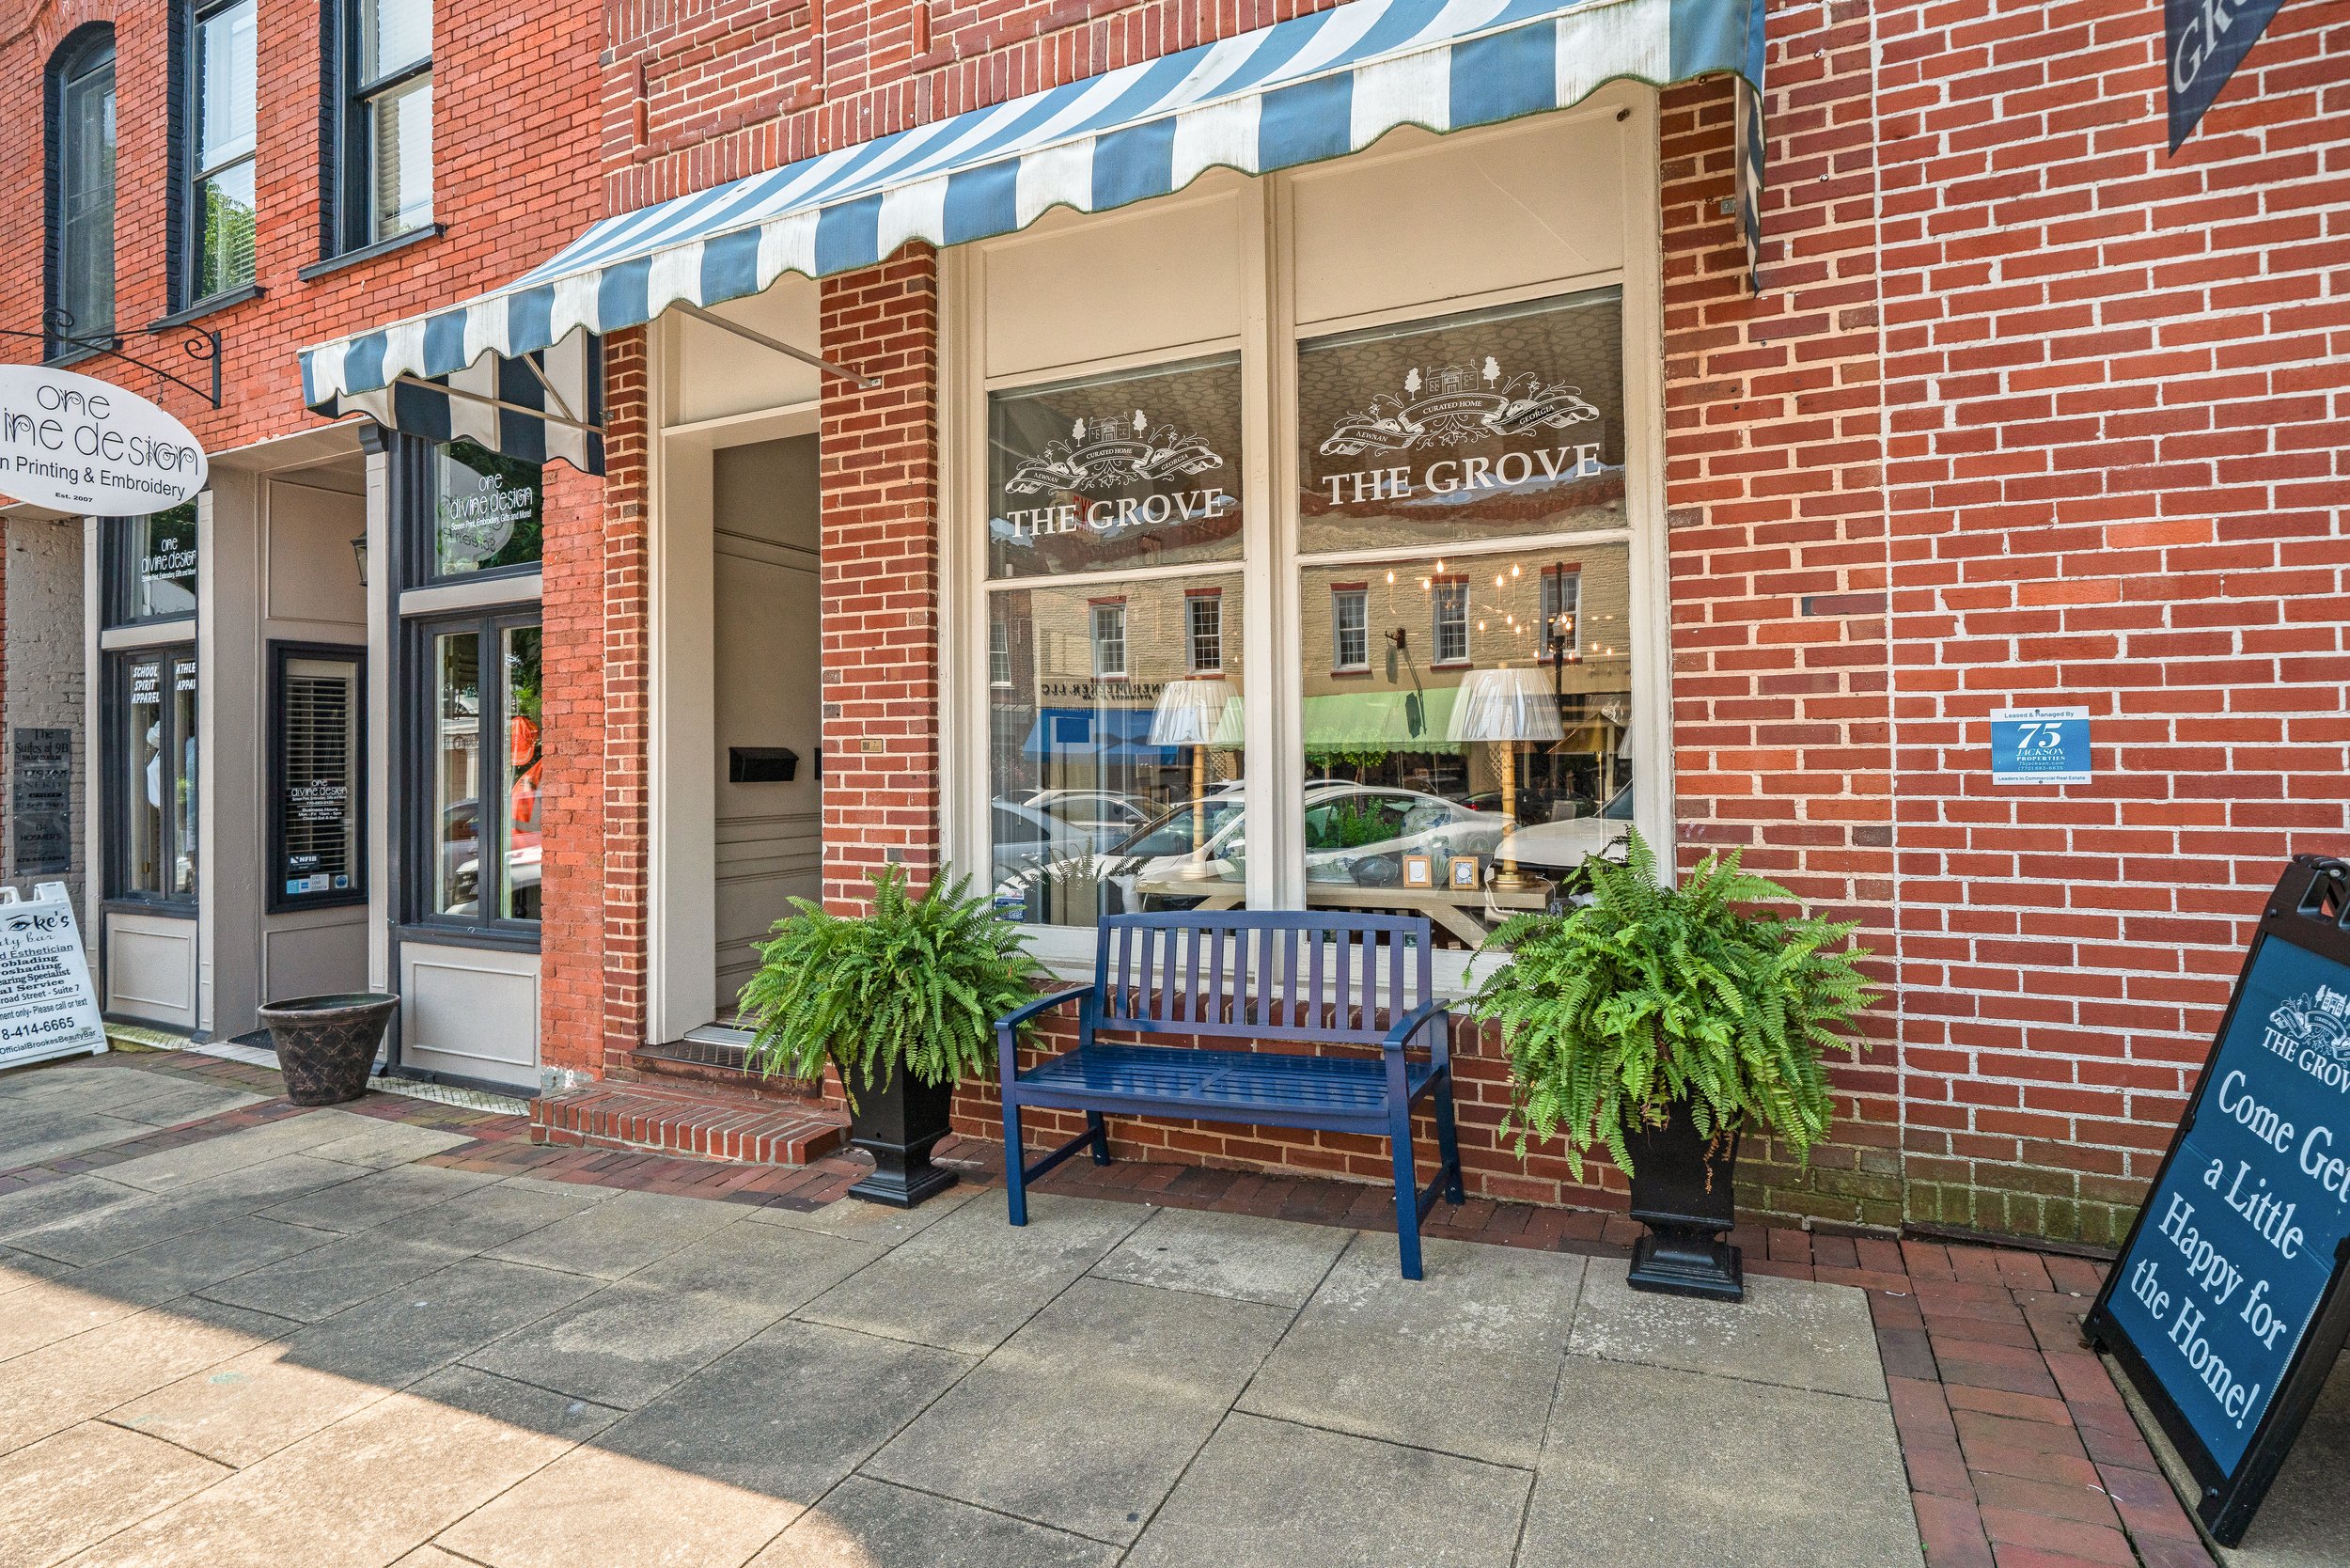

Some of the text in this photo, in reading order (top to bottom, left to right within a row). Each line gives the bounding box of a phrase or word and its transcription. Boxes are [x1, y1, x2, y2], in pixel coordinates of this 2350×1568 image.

[2173, 0, 2247, 94] GR
[37, 385, 110, 419] one
[1422, 402, 1458, 415] CURATED
[1519, 404, 1555, 425] GEORGIA
[1355, 431, 1387, 442] NEWNAN
[74, 422, 198, 475] design
[1086, 448, 1114, 460] CURATED
[1161, 454, 1189, 471] GEORGIA
[16, 456, 78, 485] Printing
[84, 467, 95, 483] &
[101, 470, 185, 501] Embroidery
[478, 473, 503, 491] one
[1034, 472, 1058, 483] NEWNAN
[1322, 443, 1601, 506] THE GROVE
[55, 492, 93, 503] Est. 2007
[450, 495, 488, 520] divine
[490, 486, 533, 512] design
[510, 511, 519, 521] and
[1007, 487, 1225, 539] THE GROVE
[161, 537, 179, 552] one
[141, 555, 167, 573] divine
[133, 666, 158, 678] SCHOOL
[134, 679, 156, 692] SPIRIT
[132, 691, 160, 704] APPAREL
[32, 729, 54, 741] The
[2017, 722, 2063, 749] 75
[15, 742, 42, 755] Suites
[55, 743, 70, 754] 9B
[2016, 748, 2064, 757] JACKSON
[291, 786, 348, 797] divine design
[10, 944, 73, 958] Esthetician
[28, 968, 70, 982] Specialist
[17, 979, 65, 992] Service
[22, 991, 47, 1001] Street
[53, 985, 73, 996] Suite
[32, 1005, 55, 1015] Please
[55, 1001, 67, 1011] call
[75, 997, 88, 1007] text
[1, 1016, 75, 1041] 8-414-6665
[2262, 1026, 2299, 1063] THE
[2218, 1070, 2295, 1154] Come
[2203, 1158, 2304, 1261] a Little
[2158, 1192, 2287, 1351] Happy for
[2131, 1259, 2261, 1430] the Home!
